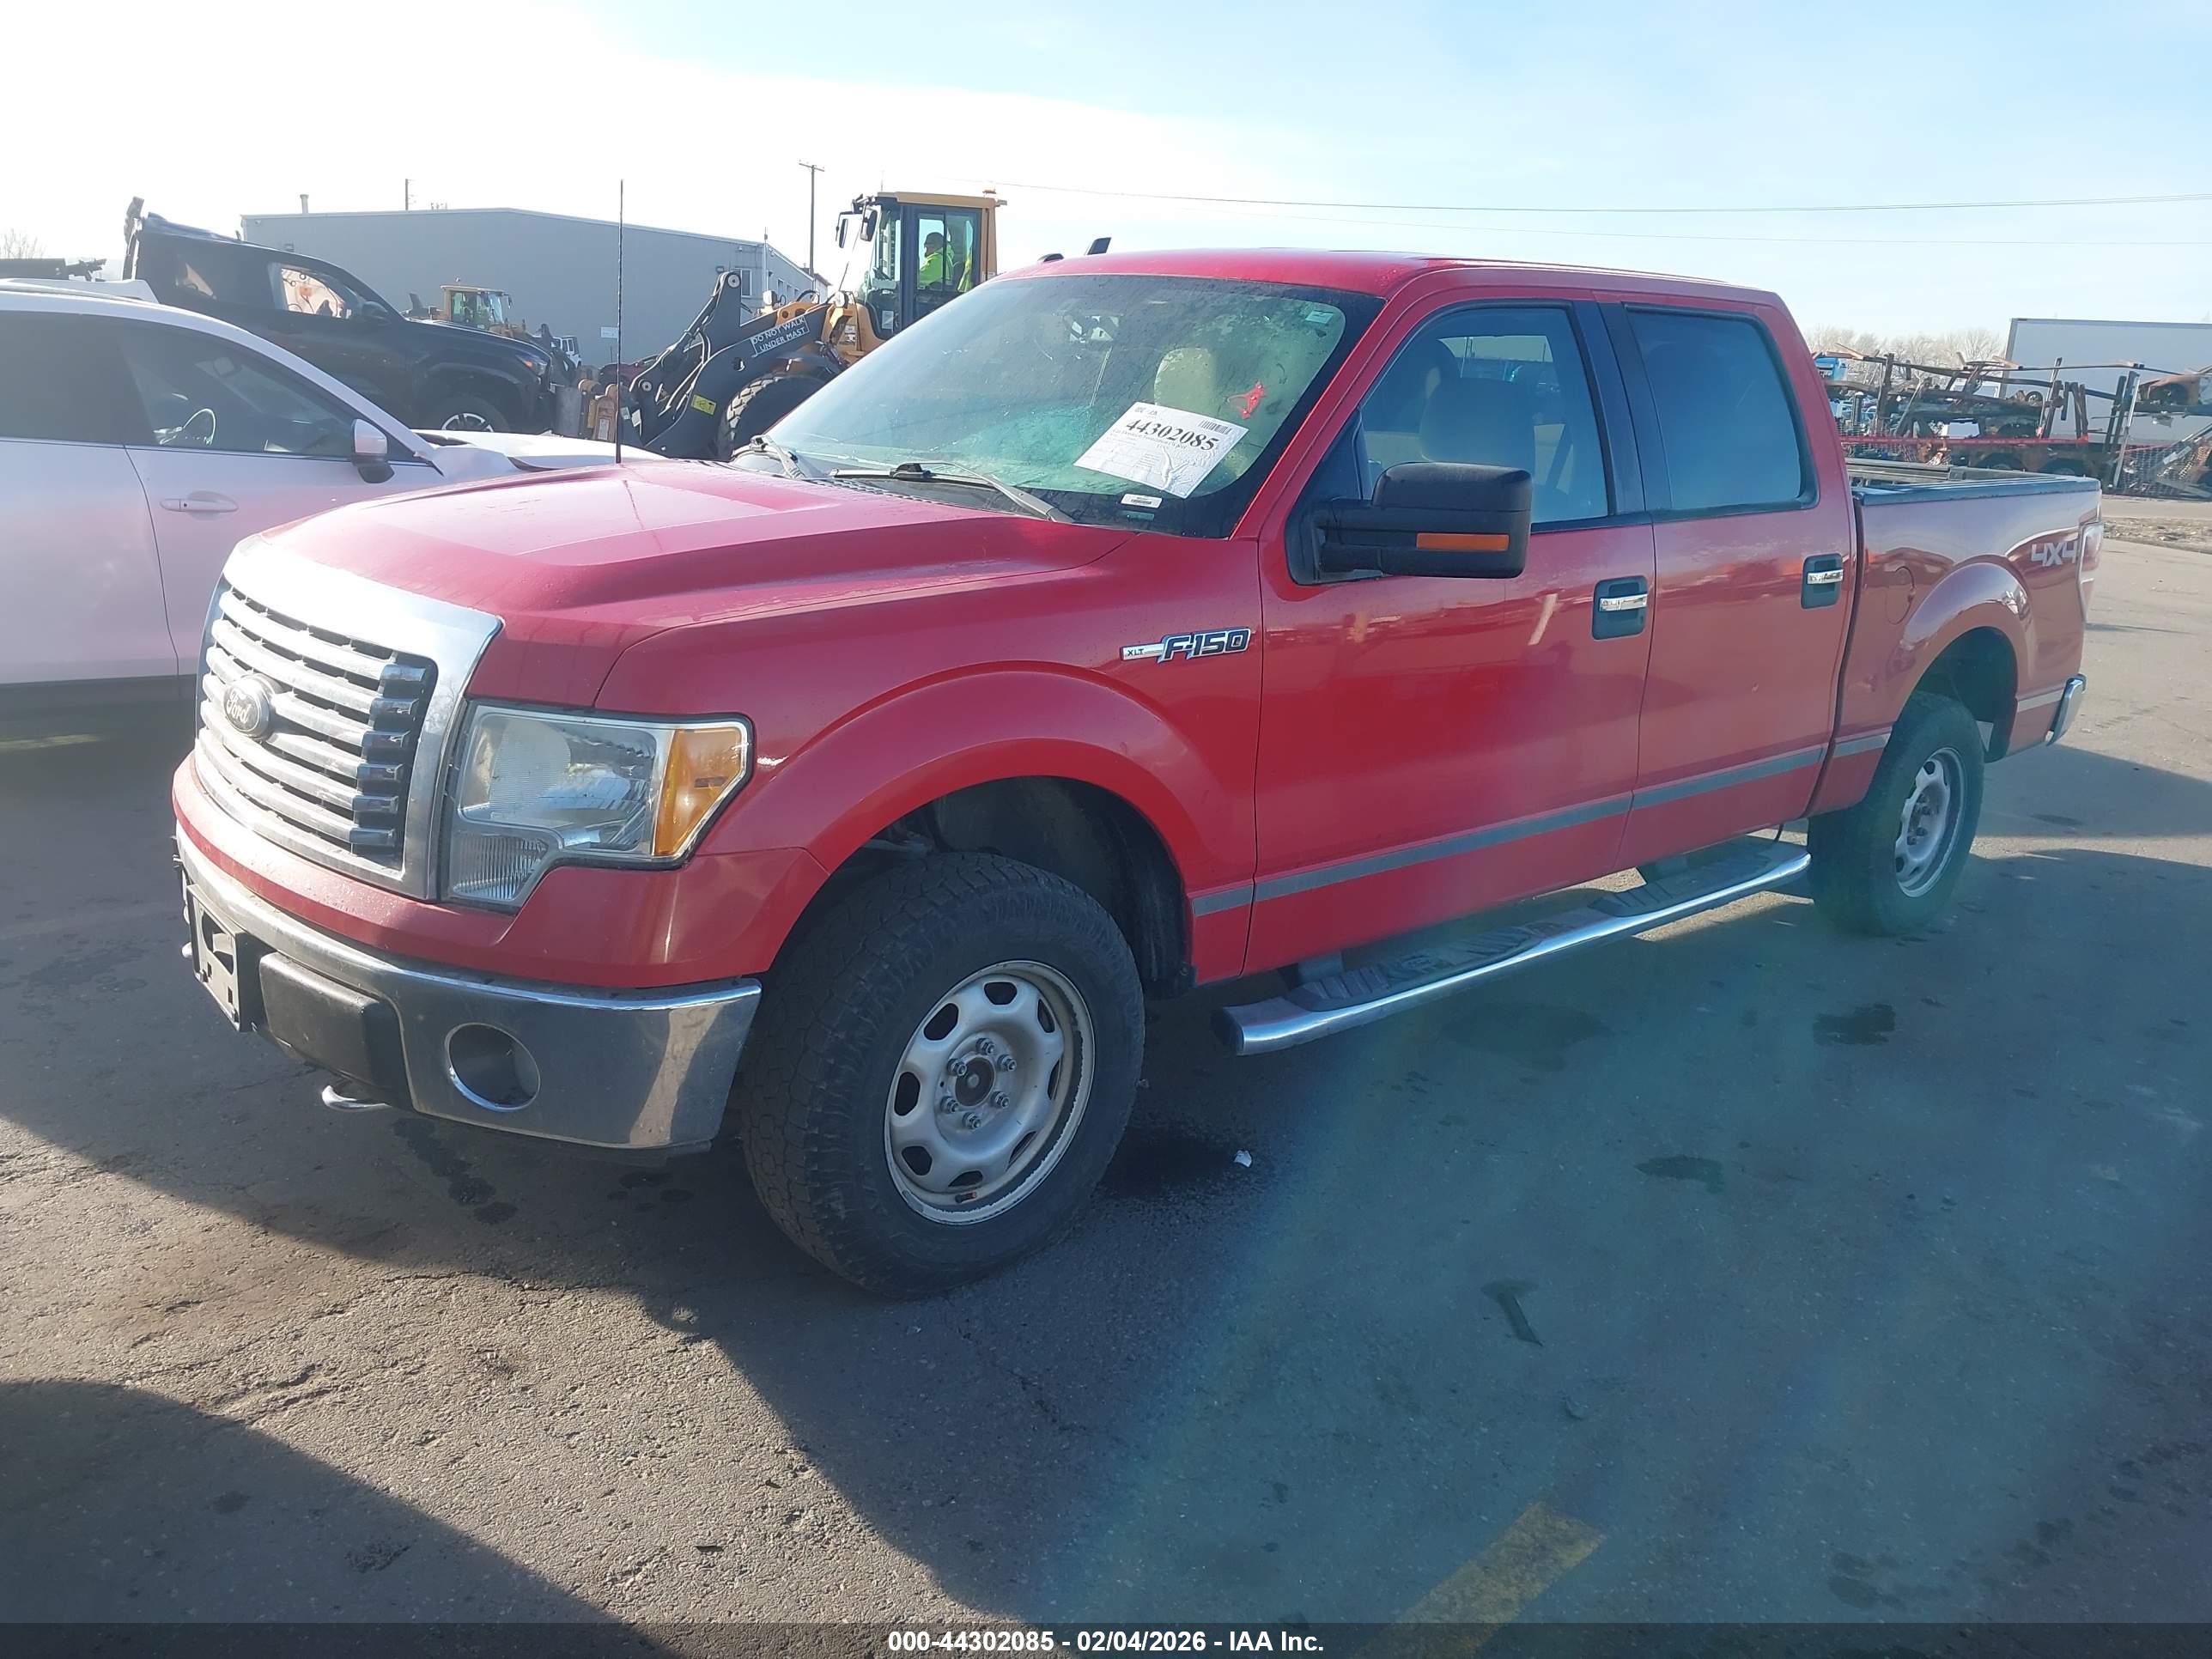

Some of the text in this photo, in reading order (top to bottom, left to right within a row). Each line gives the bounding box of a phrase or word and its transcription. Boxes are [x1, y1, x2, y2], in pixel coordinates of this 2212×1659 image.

[759, 327, 805, 351] UNDER MAST
[765, 327, 782, 339] NOT
[783, 317, 805, 331] WALK
[1126, 419, 1219, 451] 44302085
[1163, 629, 1250, 660] F-150
